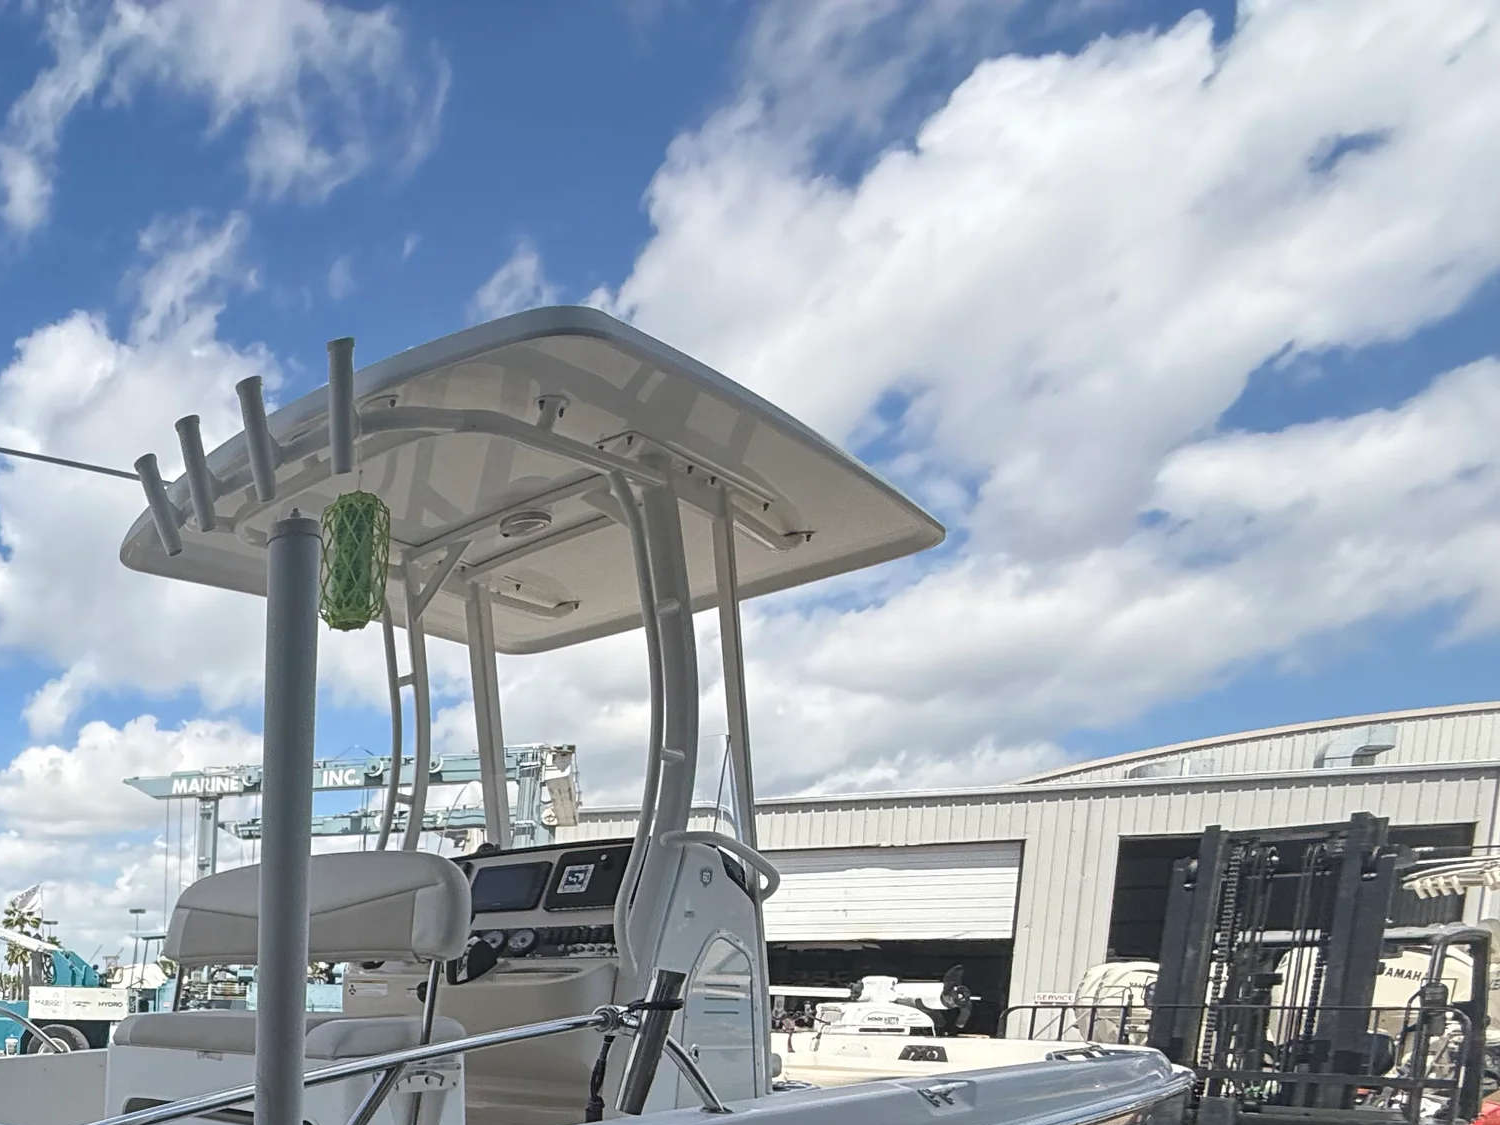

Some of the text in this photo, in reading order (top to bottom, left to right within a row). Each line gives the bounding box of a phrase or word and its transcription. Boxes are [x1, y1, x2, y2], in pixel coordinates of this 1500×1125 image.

[172, 769, 361, 794] MARINE INC.
[1383, 966, 1424, 982] AMAH
[1036, 994, 1072, 1002] SERVICE
